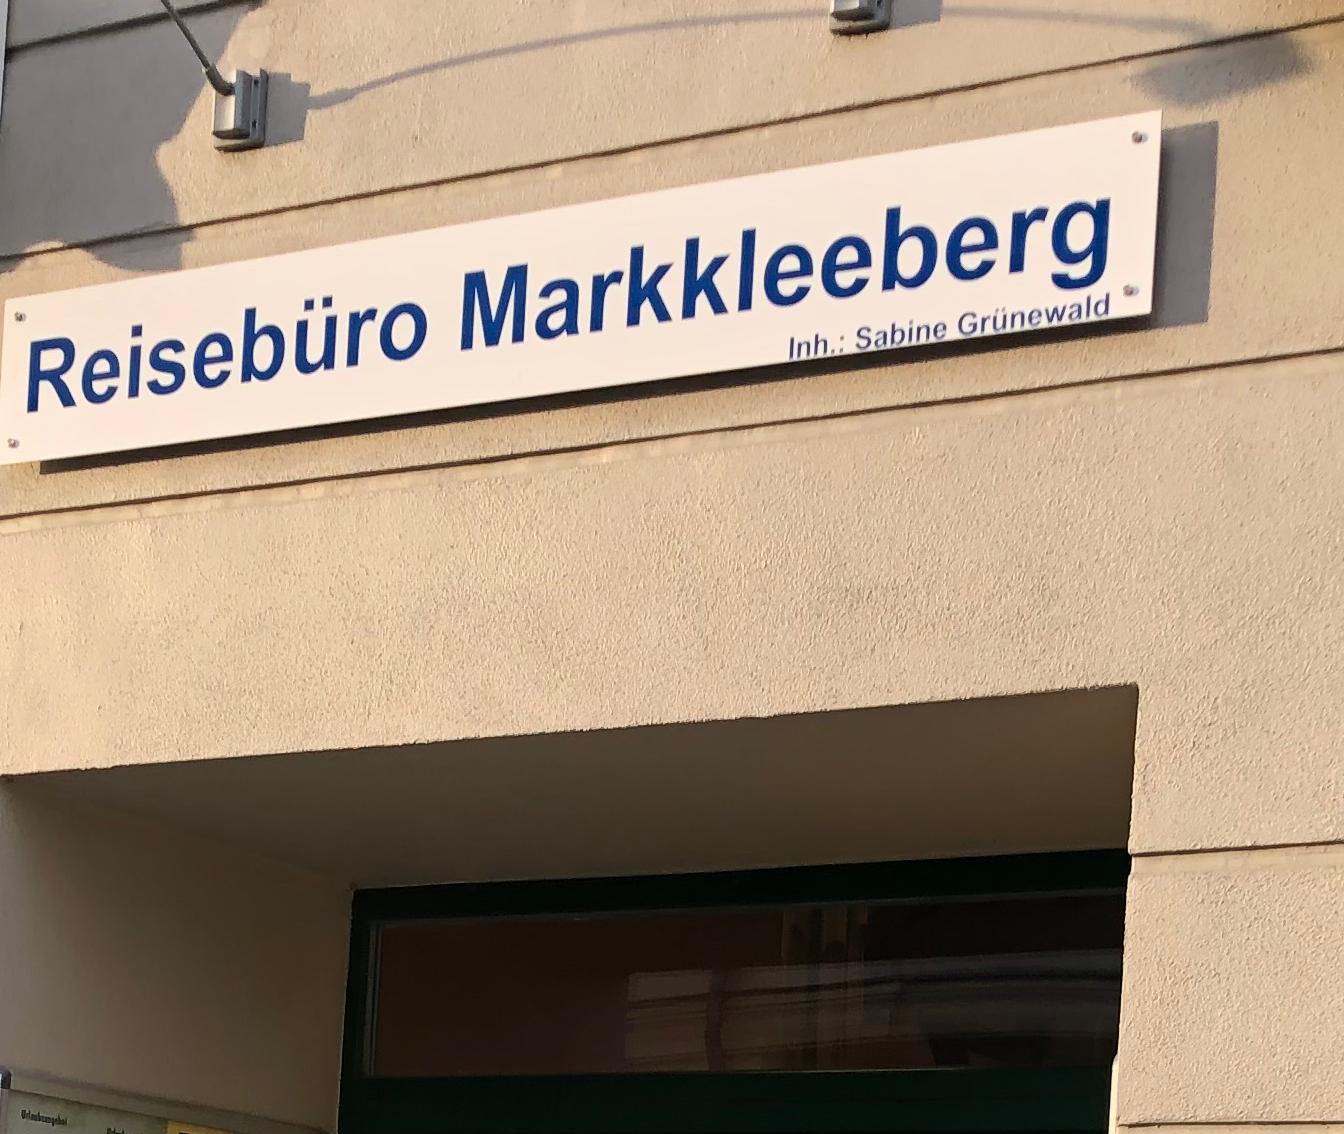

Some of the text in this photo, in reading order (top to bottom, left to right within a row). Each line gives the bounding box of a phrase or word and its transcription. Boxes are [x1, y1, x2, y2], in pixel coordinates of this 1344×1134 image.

[26, 197, 1111, 413] Reisebüro Markkleeberg
[787, 293, 1110, 360] Inh.: Sabine Grünewald
